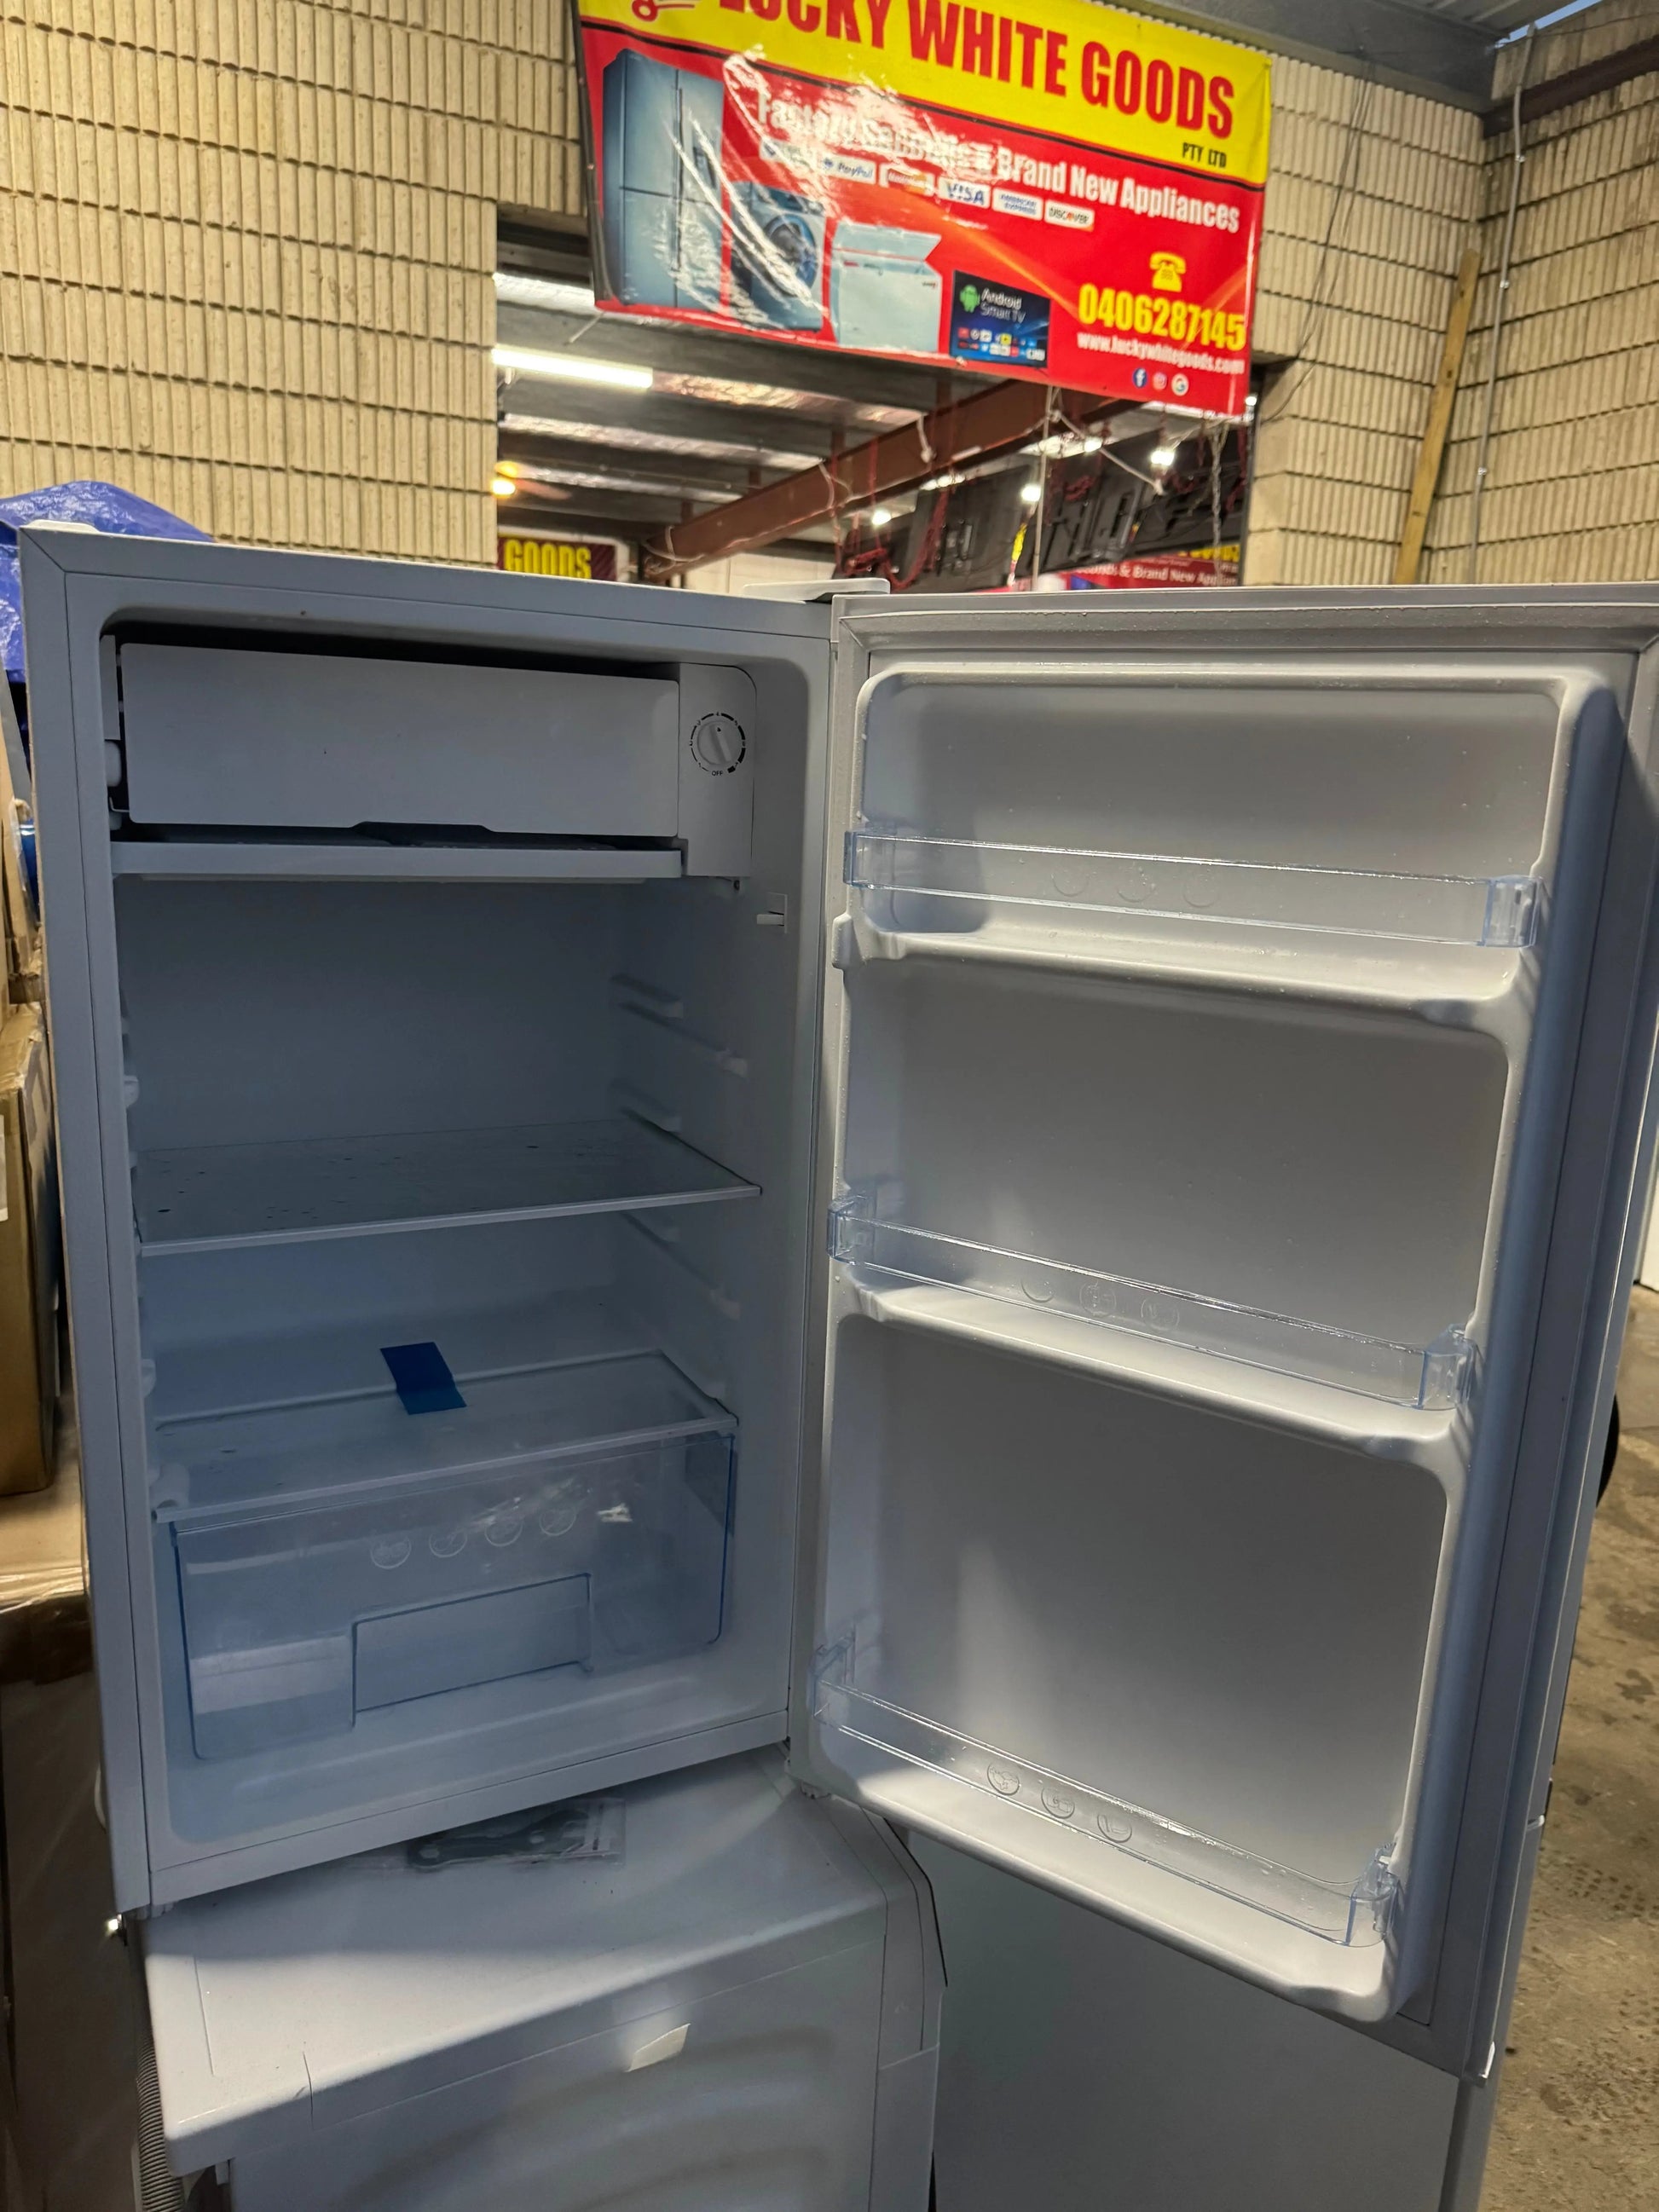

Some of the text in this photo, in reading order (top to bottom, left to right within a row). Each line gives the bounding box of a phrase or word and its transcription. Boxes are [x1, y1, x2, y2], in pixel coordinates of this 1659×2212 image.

[720, 0, 1234, 139] CKY WHITE GOODS
[1182, 141, 1227, 168] PTY LTD
[946, 182, 985, 205] VISA
[997, 146, 1240, 234] Brand New Appliances
[980, 302, 1011, 321] Smart
[981, 288, 1022, 310] Android
[1078, 282, 1246, 351] 0406287145
[504, 539, 592, 580] GOODS
[1133, 564, 1169, 581] Brand
[1170, 569, 1196, 584] New
